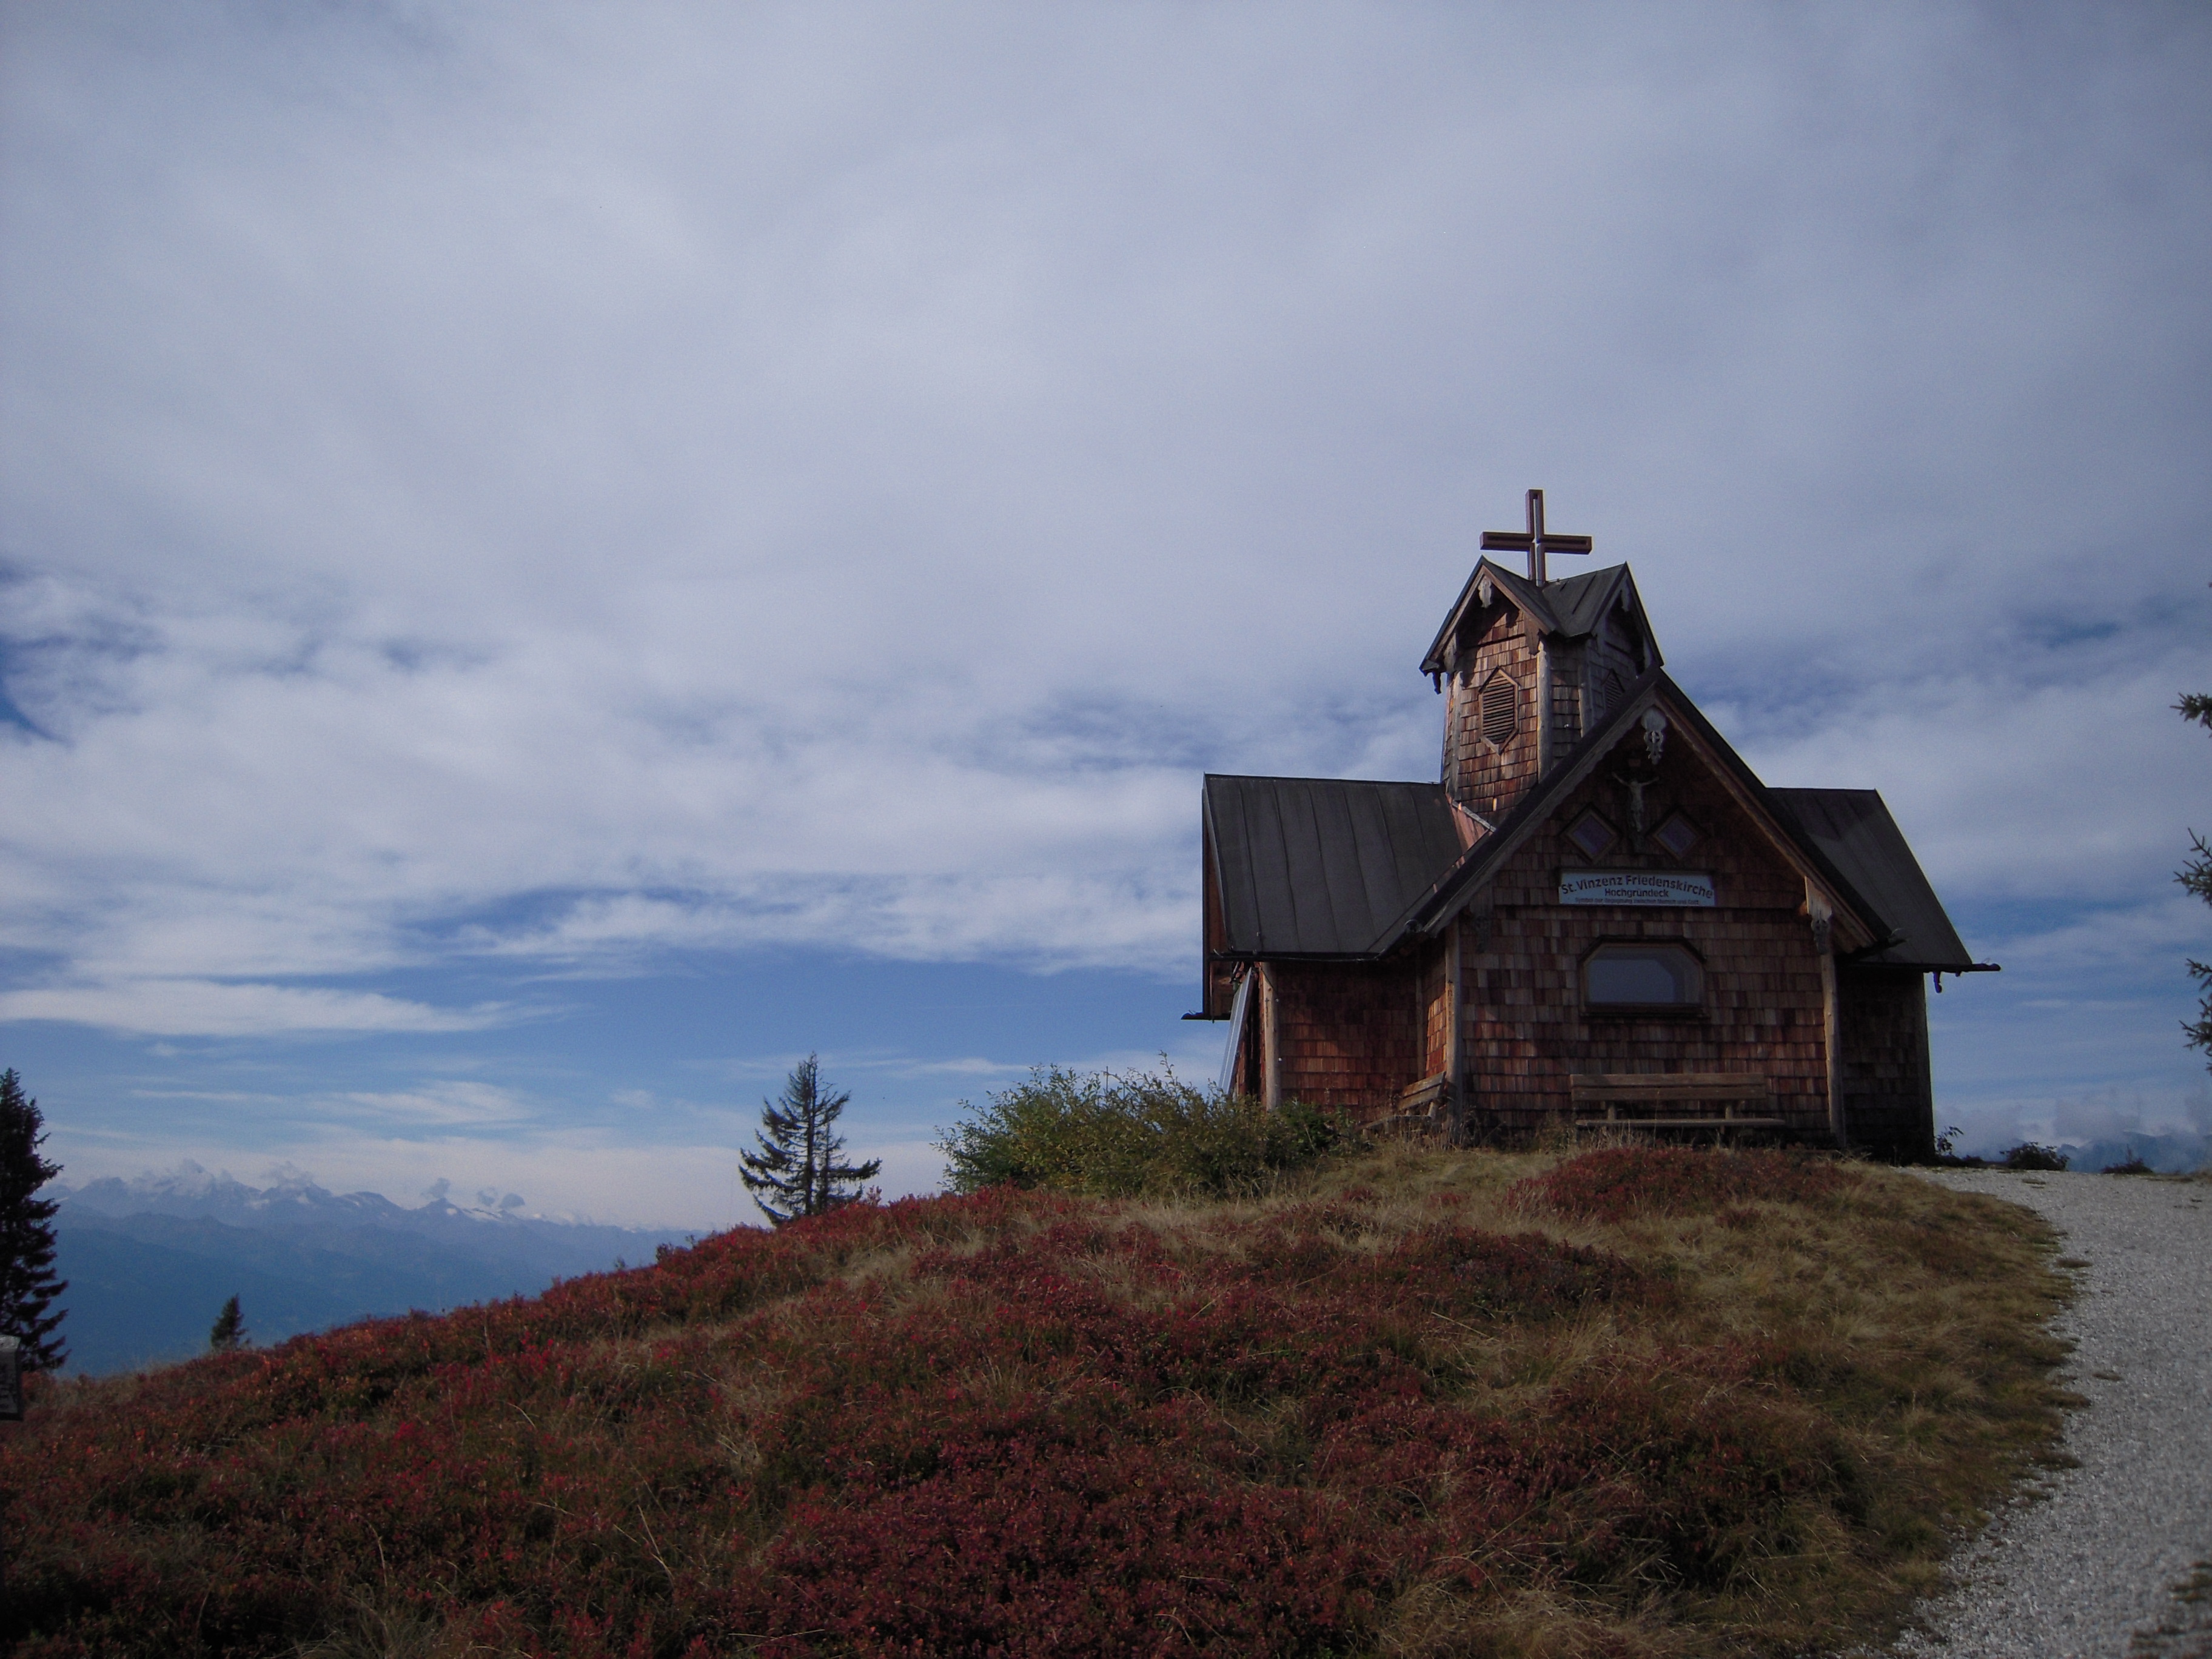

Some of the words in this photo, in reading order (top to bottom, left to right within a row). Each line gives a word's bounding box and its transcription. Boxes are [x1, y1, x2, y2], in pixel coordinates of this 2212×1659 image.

[1561, 883, 1577, 894] St.
[1576, 876, 1623, 890] Vinzenz
[1626, 875, 1713, 899] Friedenskirche
[1604, 888, 1669, 898] Hochgründeck
